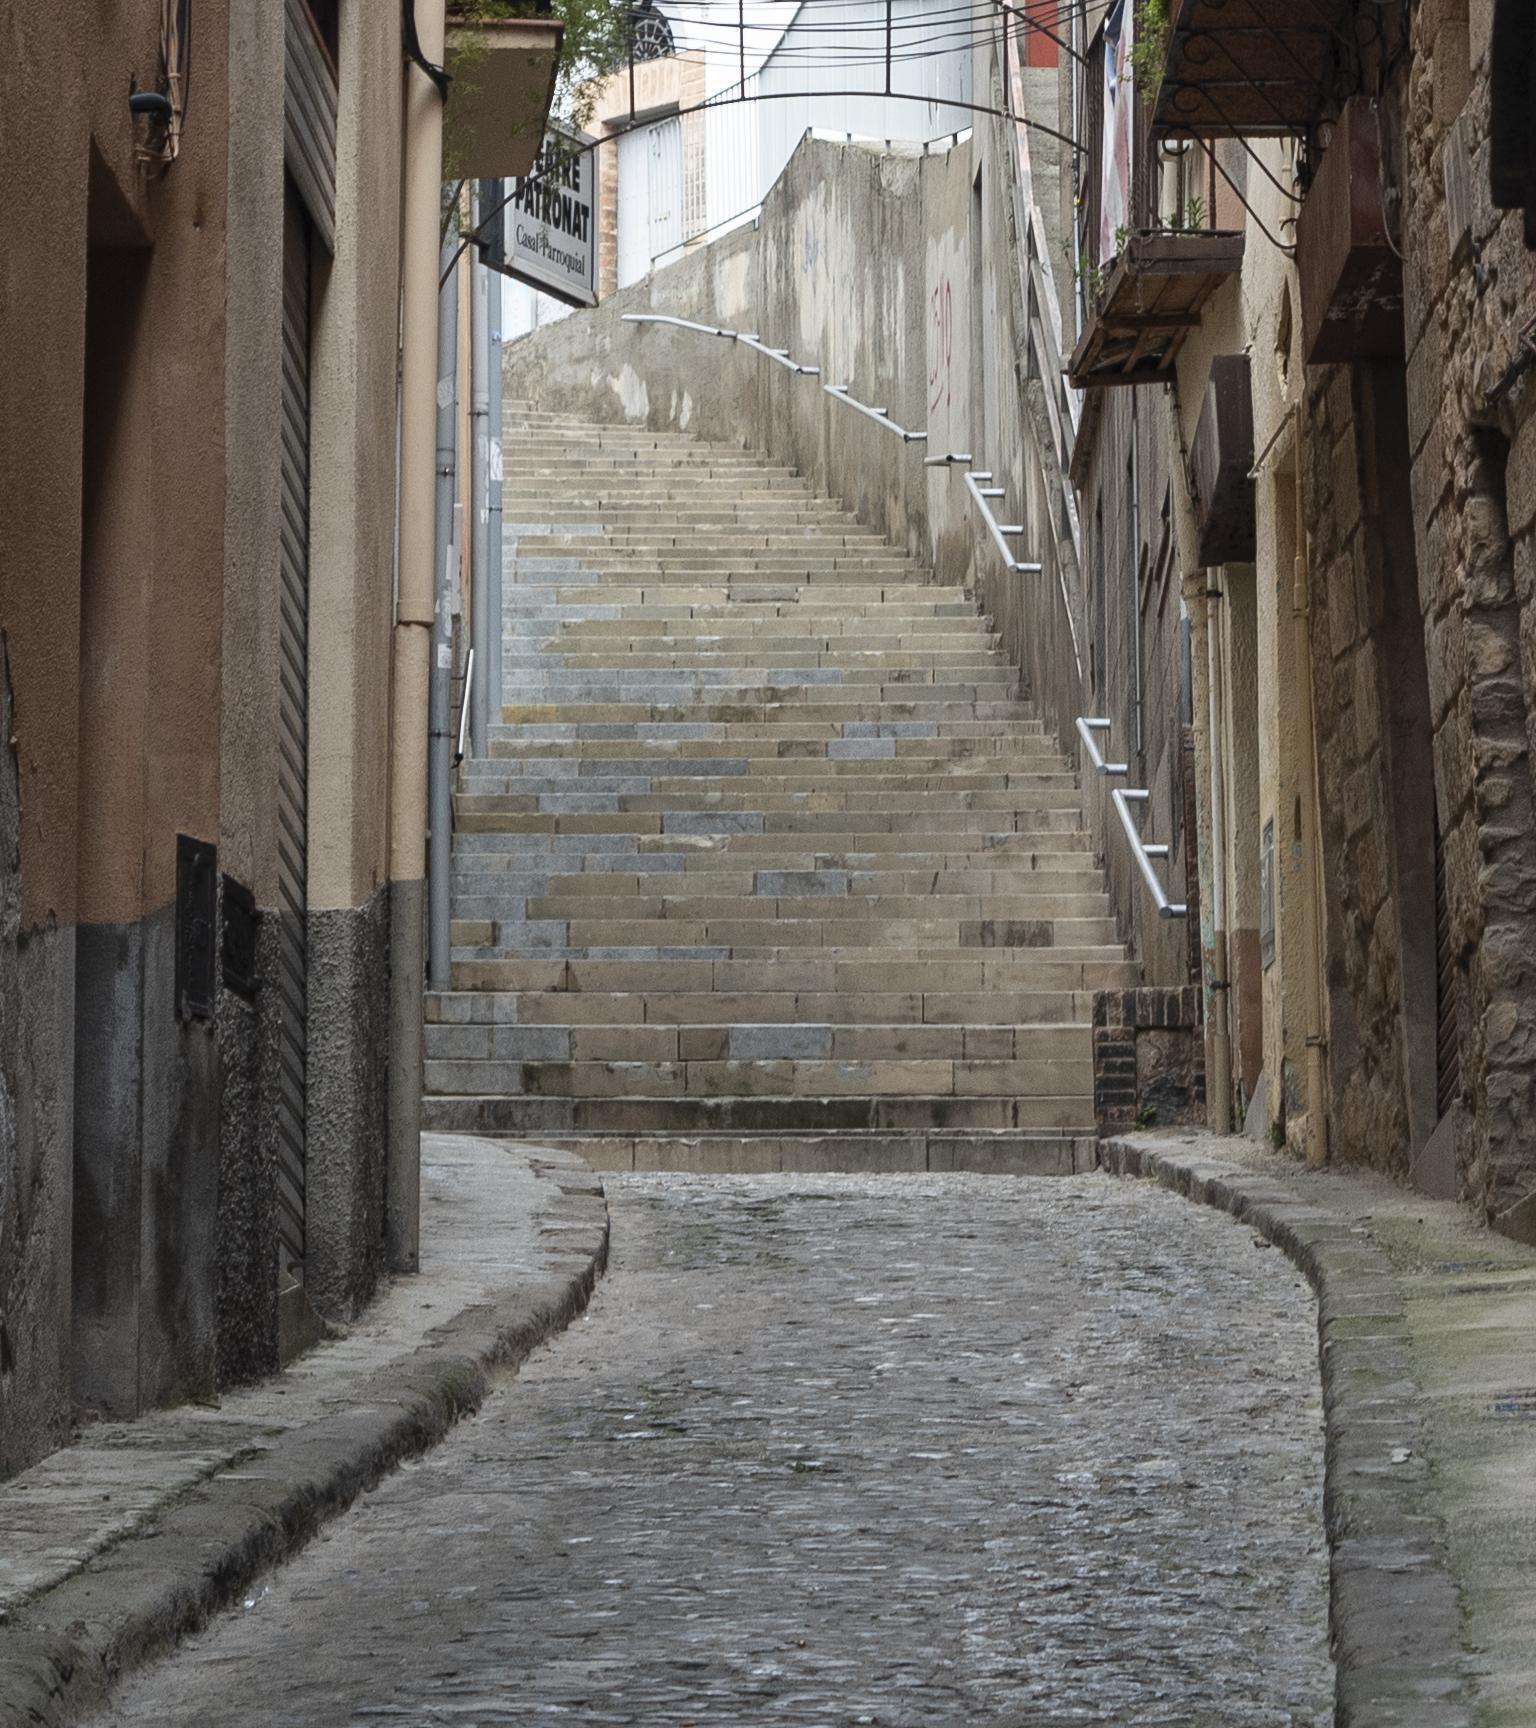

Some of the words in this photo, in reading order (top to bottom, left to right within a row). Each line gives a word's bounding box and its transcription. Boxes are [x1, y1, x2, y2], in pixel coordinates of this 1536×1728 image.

[515, 175, 590, 244] PATRONAT
[516, 224, 539, 253] Casal
[542, 235, 585, 277] Parroquial
